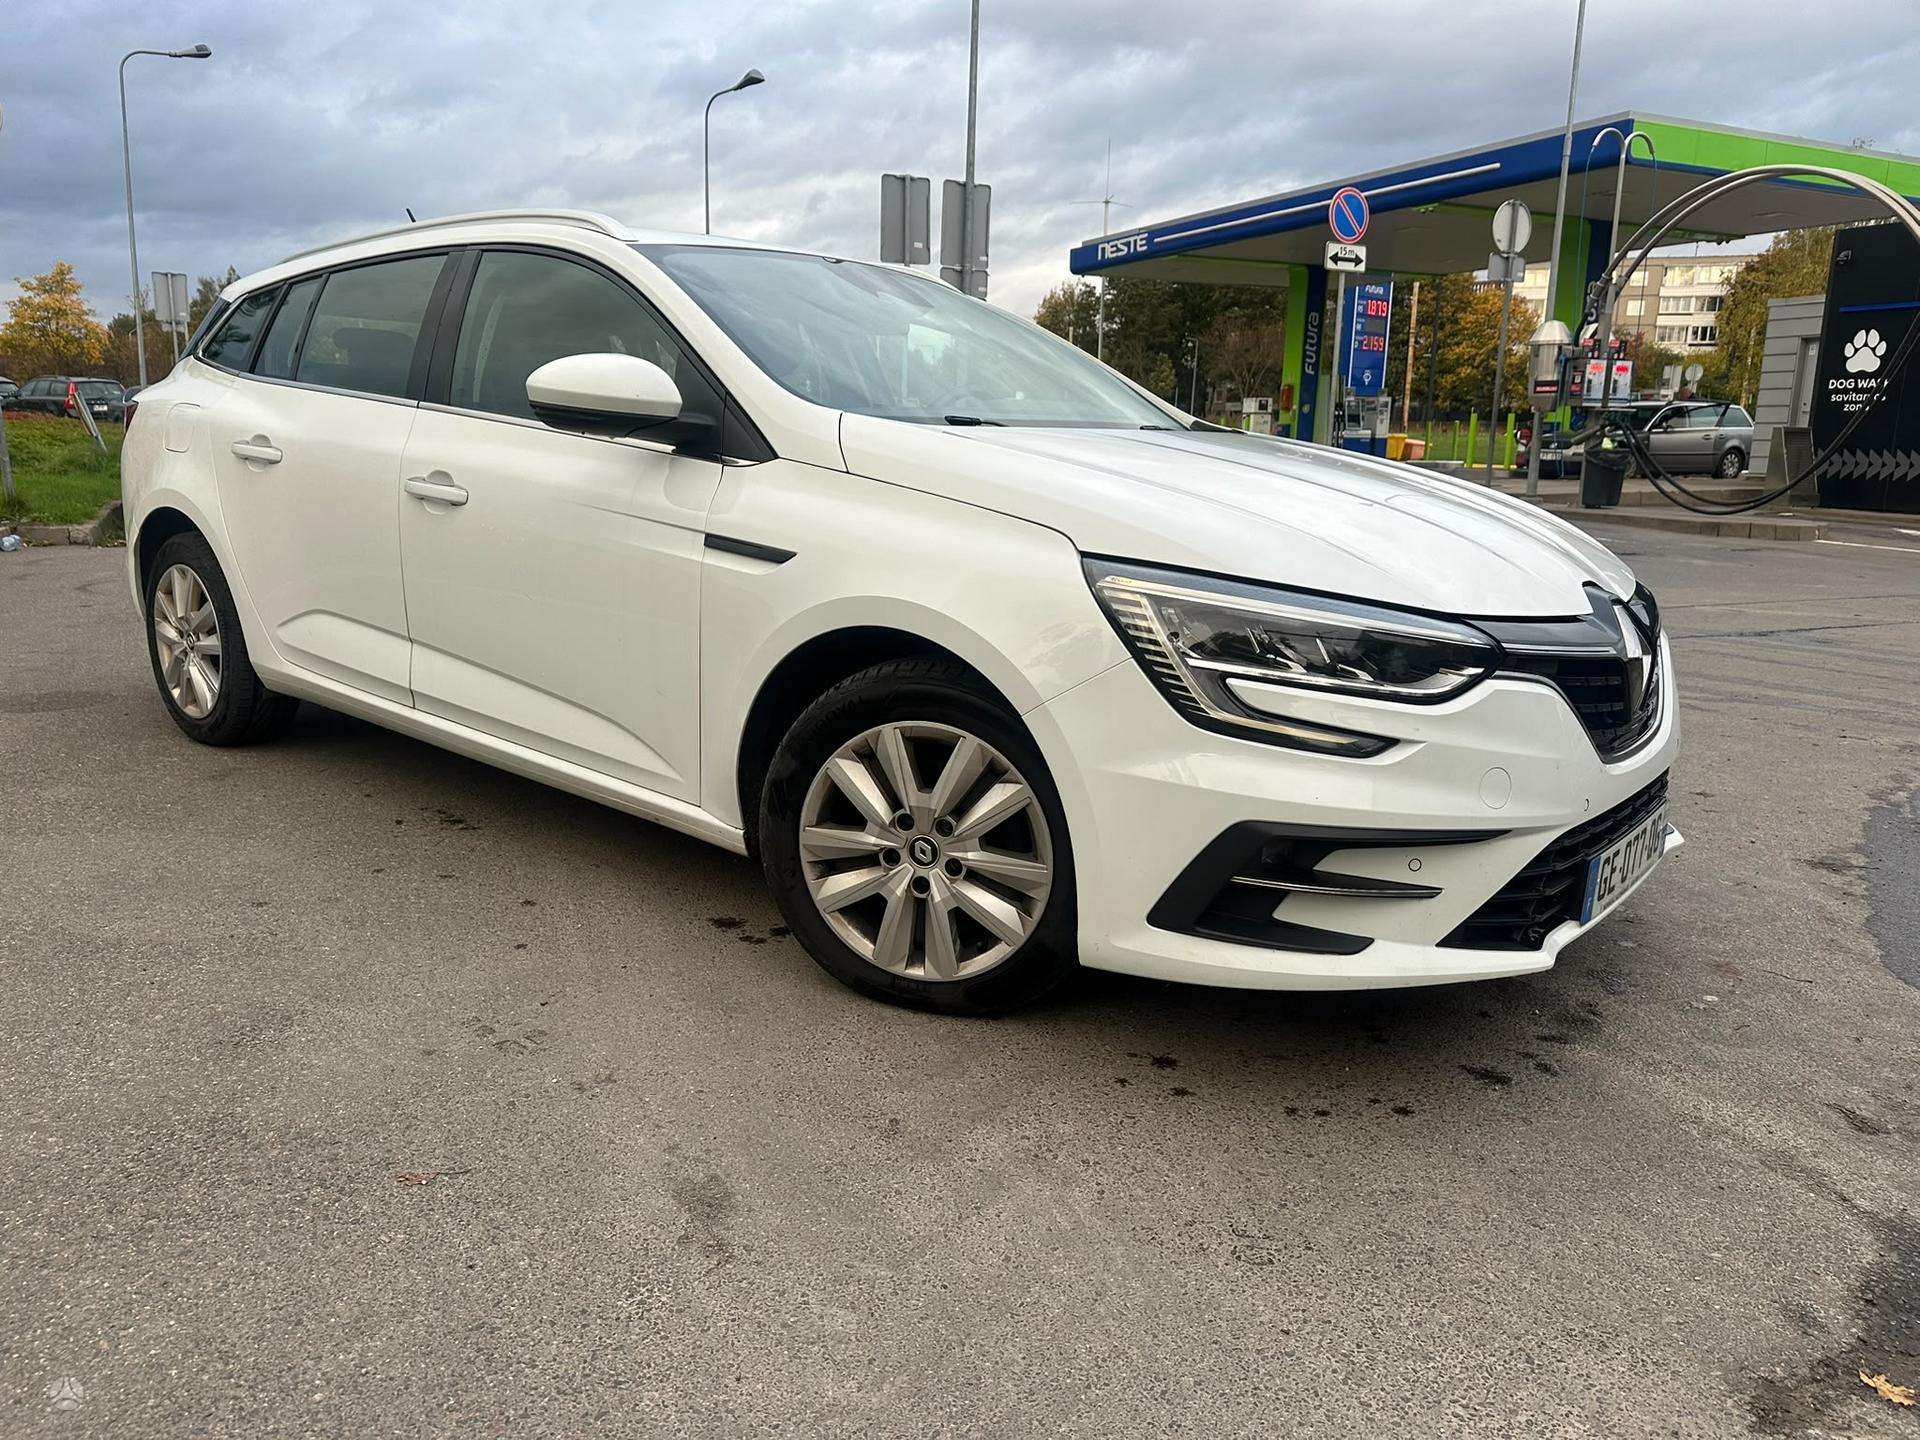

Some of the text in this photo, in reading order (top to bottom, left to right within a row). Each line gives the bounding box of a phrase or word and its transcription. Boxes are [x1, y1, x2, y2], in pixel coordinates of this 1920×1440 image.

[1097, 232, 1149, 261] NESTE
[1828, 379, 1855, 389] DOG
[1830, 391, 1886, 401] savitar
